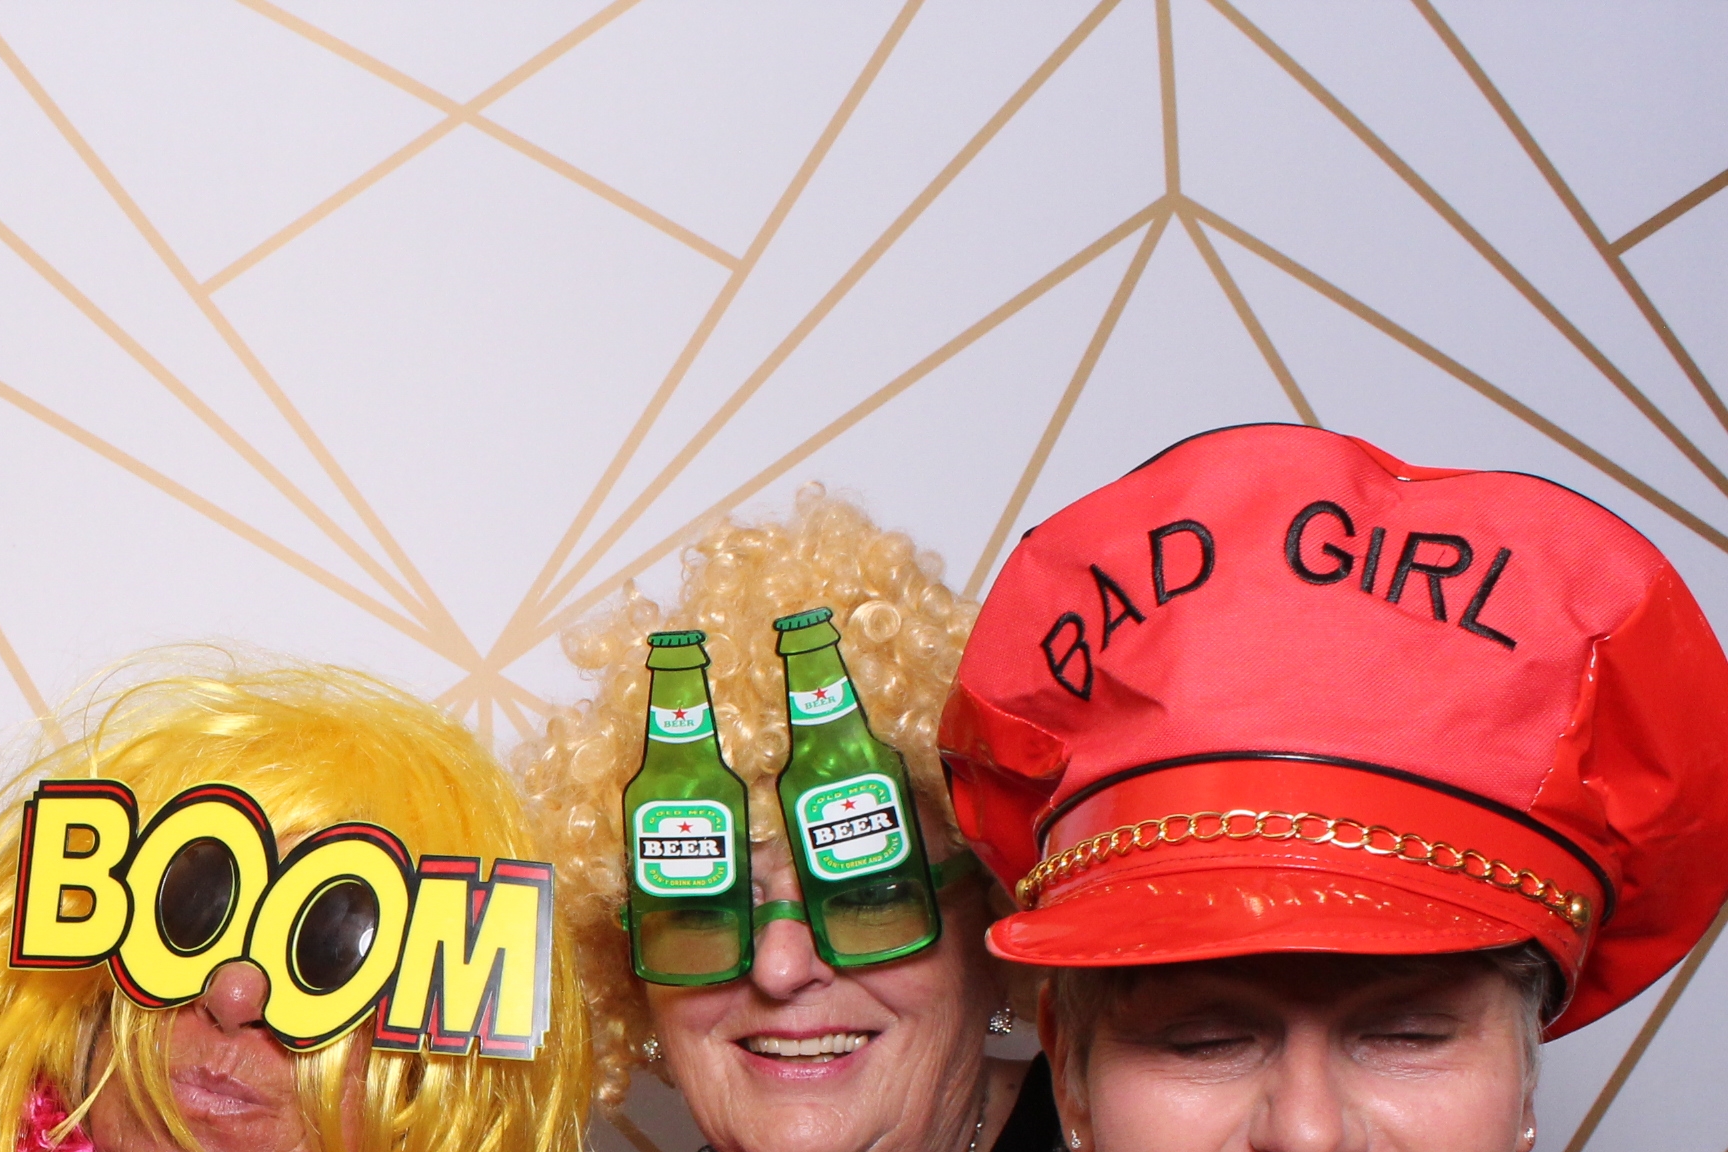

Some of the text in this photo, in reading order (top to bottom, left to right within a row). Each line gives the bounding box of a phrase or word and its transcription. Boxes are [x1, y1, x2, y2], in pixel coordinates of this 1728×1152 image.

[1040, 500, 1518, 701] BAD GIRL
[805, 696, 836, 710] BEER
[663, 719, 695, 729] BEER
[812, 784, 886, 812] GOLD MEDAL
[649, 810, 722, 829] GOLD MEDAL
[813, 812, 893, 846] BEER
[643, 839, 720, 857] BEER
[845, 859, 867, 869] DRINK
[868, 855, 883, 863] AND
[9, 778, 554, 1060] BOOM
